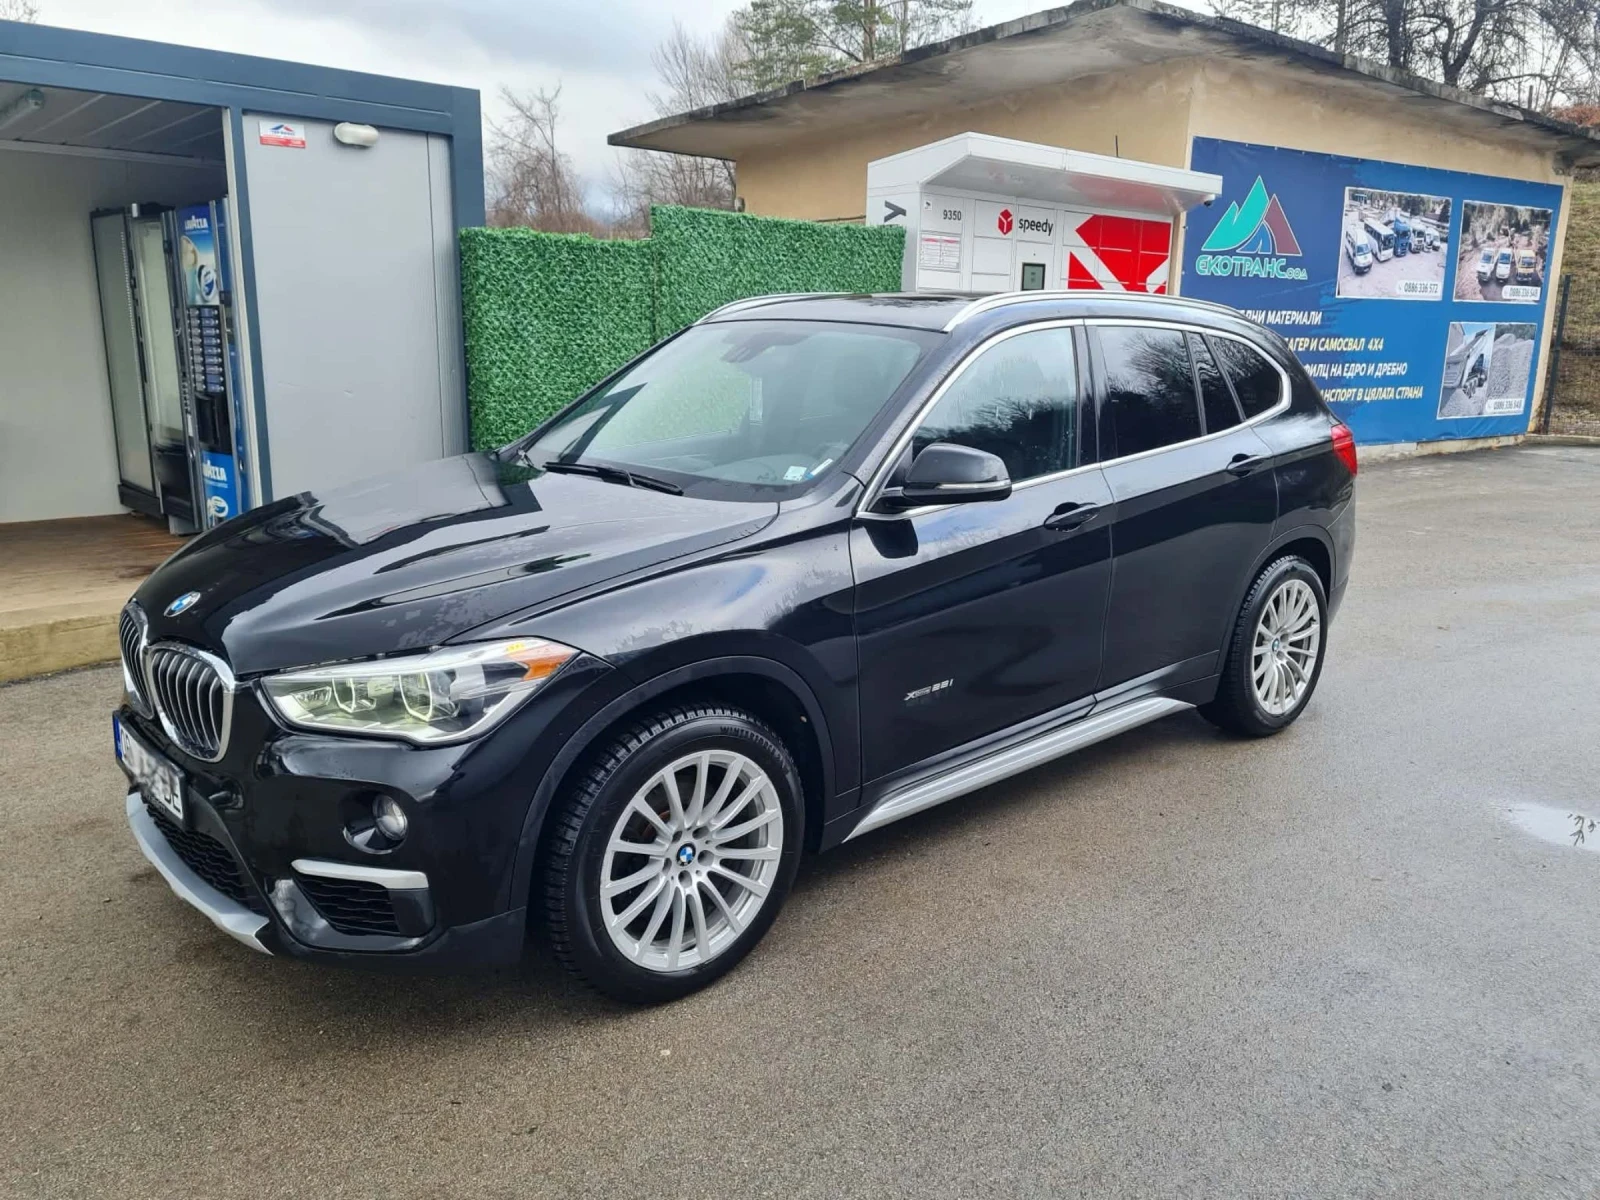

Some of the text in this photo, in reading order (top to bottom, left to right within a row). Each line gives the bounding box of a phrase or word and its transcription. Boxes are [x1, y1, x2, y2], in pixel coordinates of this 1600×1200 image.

[943, 209, 962, 221] 9350
[1018, 217, 1054, 236] speedy
[1404, 282, 1418, 293] 0886
[1418, 282, 1428, 293] 336
[1266, 309, 1322, 325] МАТЕРИАЛИ
[1284, 337, 1310, 351] АГЕР
[1309, 337, 1318, 351] И
[1318, 337, 1366, 352] САМОСВАЛ
[1330, 363, 1342, 377] НА
[1343, 363, 1366, 379] ЕДРО
[1366, 363, 1375, 376] И
[1374, 362, 1408, 379] ДРЕБНО
[1356, 387, 1364, 401] В
[1363, 386, 1394, 403] ЦЯЛАТА
[1395, 386, 1424, 400] СТРАНА
